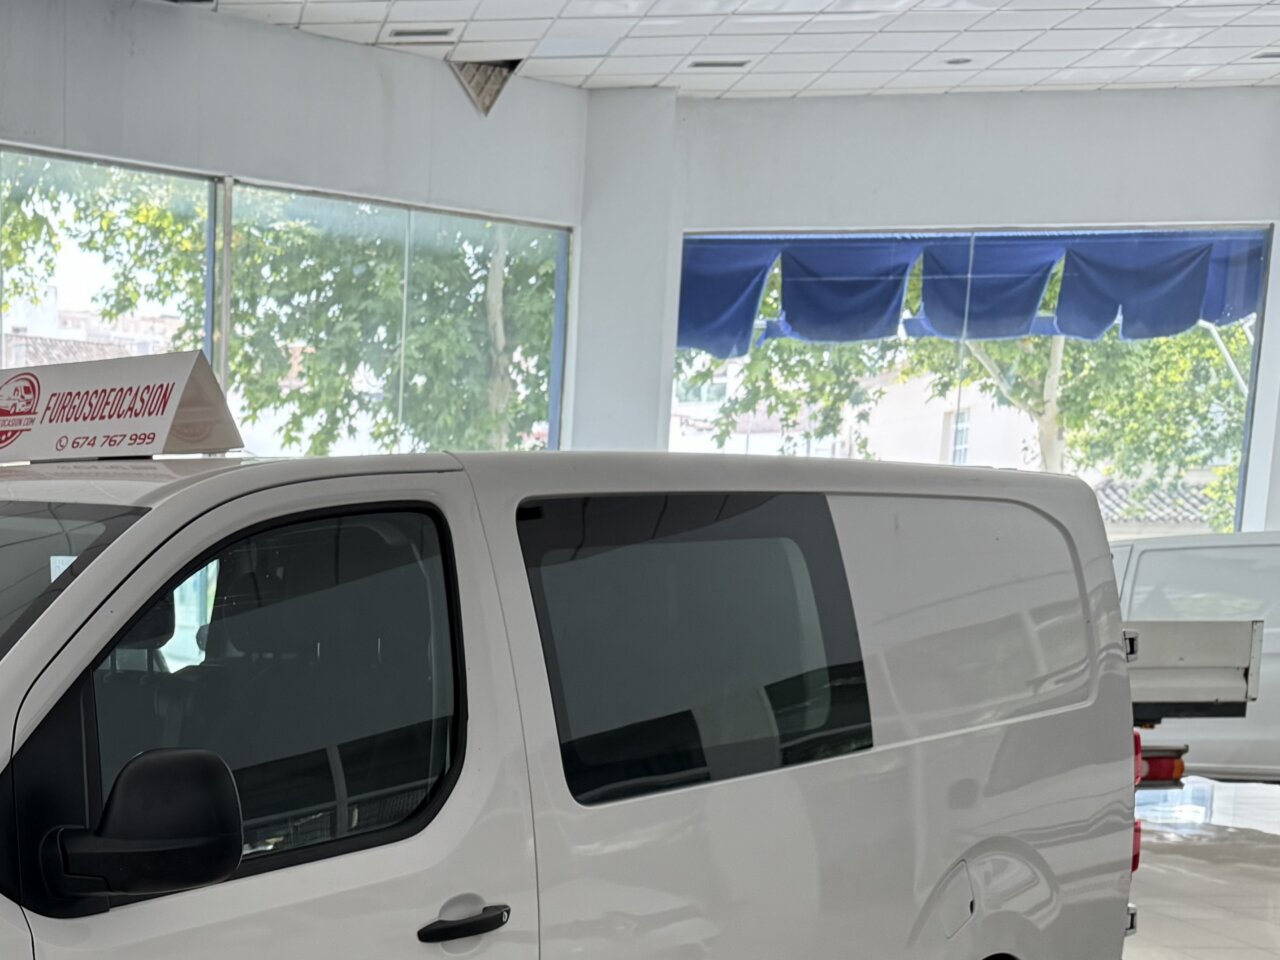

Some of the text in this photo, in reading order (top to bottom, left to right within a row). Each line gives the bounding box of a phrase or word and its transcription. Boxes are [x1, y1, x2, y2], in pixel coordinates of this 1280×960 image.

[40, 382, 176, 425] FURGOSDEOCASION
[71, 432, 156, 449] 674 767 999
